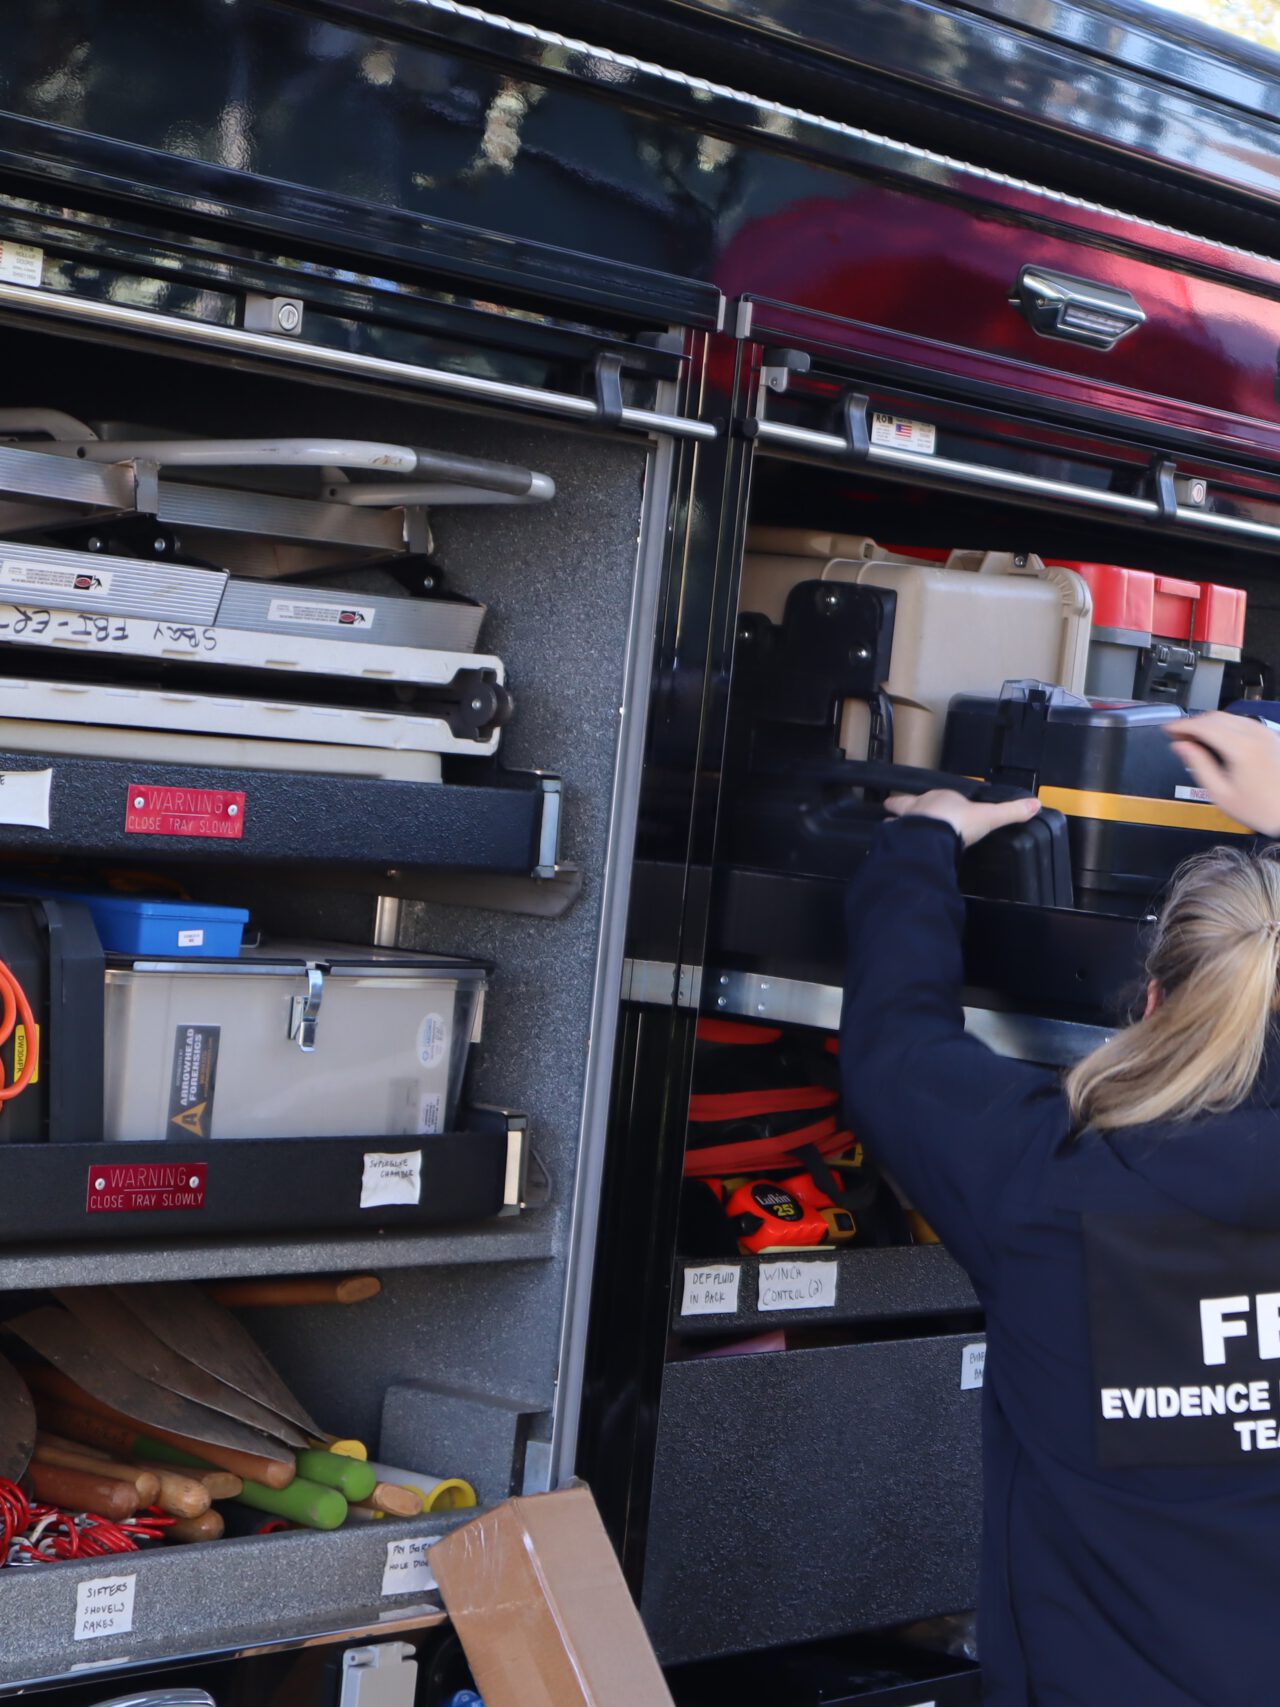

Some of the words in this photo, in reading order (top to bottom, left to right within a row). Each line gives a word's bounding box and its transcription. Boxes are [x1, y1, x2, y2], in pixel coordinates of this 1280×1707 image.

[149, 791, 223, 814] WARNING
[128, 816, 161, 830] CLOSE
[169, 818, 193, 832] TRAY
[200, 821, 241, 834] SLOWLY
[180, 1029, 194, 1106] ARROWHEAD
[189, 1033, 202, 1101] FORENSICS
[110, 1167, 187, 1187] WARNING
[90, 1195, 125, 1209] CLOSE
[132, 1194, 157, 1207] TRAY
[162, 1192, 204, 1206] SLOWLY
[692, 1272, 711, 1285] DEF
[713, 1271, 735, 1285] FLUID
[690, 1294, 699, 1305] IN
[704, 1291, 725, 1305] BACK
[1101, 1381, 1271, 1420] EVIDENCE
[86, 1582, 128, 1599] SIFTERS
[84, 1602, 125, 1616] SHOVELS
[82, 1618, 114, 1633] RAKES
